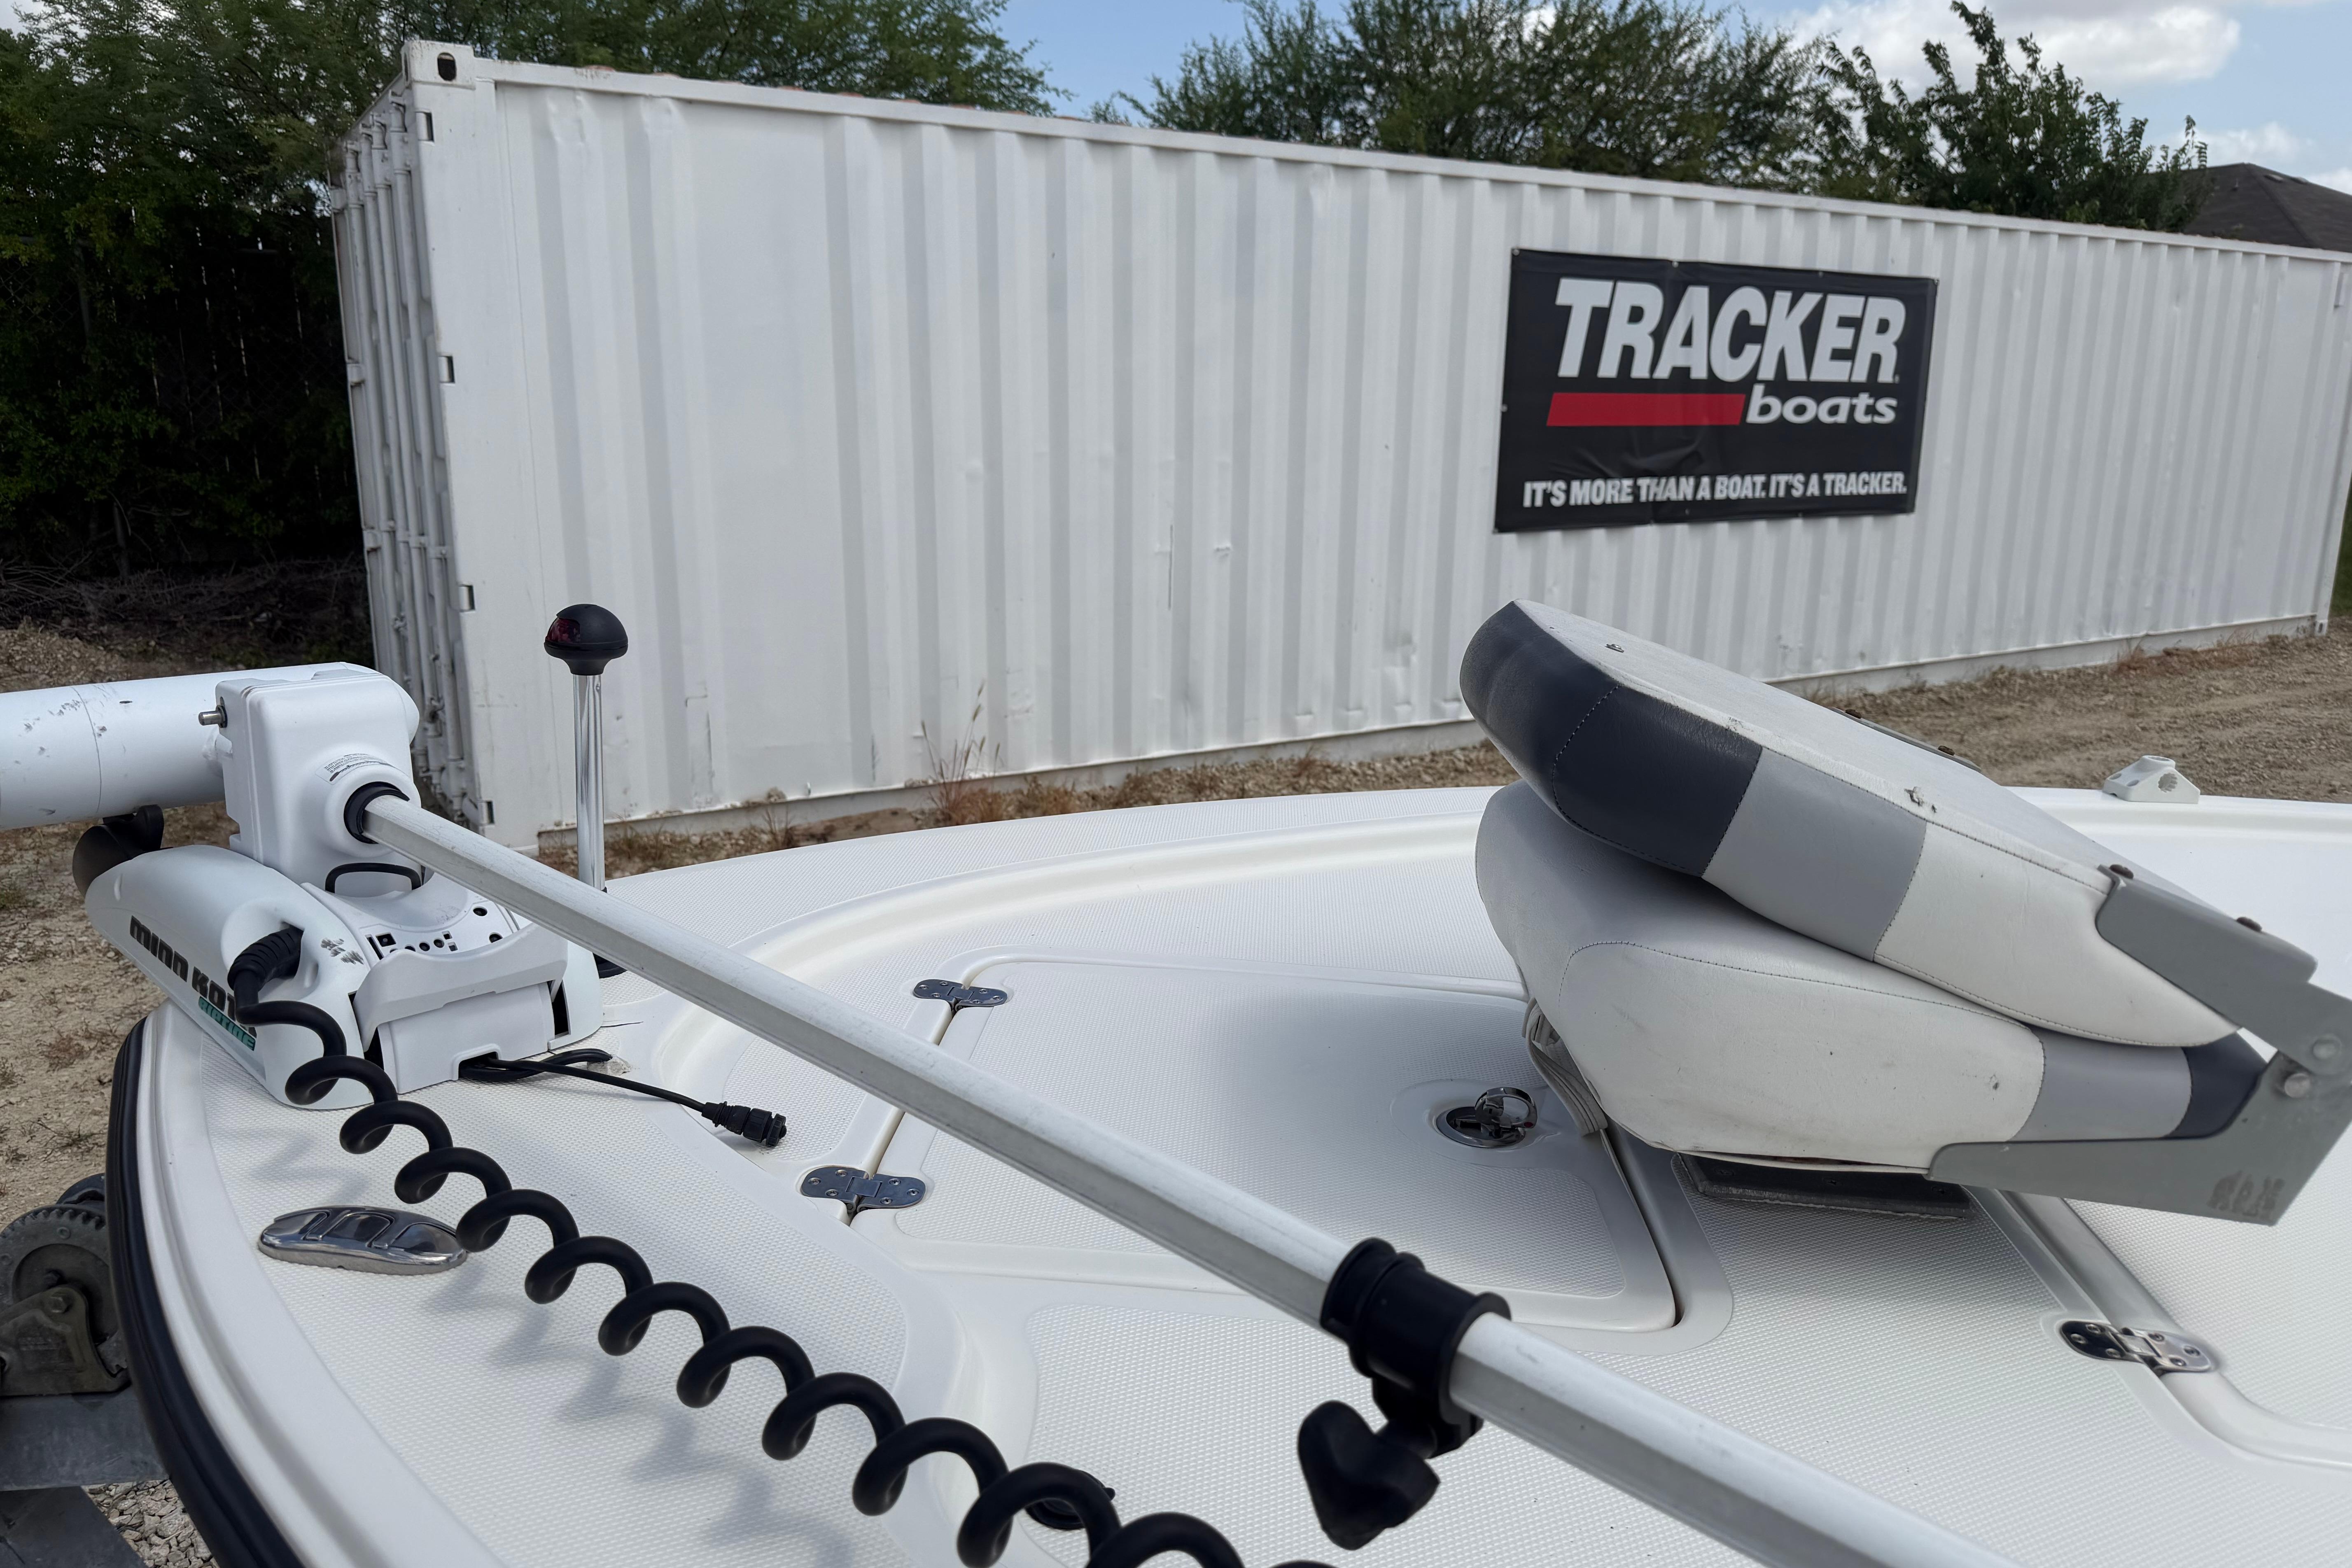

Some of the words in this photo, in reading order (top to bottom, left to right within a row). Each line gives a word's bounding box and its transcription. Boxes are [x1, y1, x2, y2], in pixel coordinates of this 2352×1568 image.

[1555, 277, 1906, 383] TRACKER
[1746, 383, 1898, 424] boats
[1523, 480, 1567, 507] IT'S
[1568, 478, 1634, 506] MORE
[1636, 476, 1695, 502] THAN
[1695, 475, 1712, 501] A
[1714, 474, 1766, 500] BOAT.
[1769, 473, 1805, 498] IT'S
[1806, 472, 1820, 497] A
[1822, 471, 1907, 496] TRACKER.
